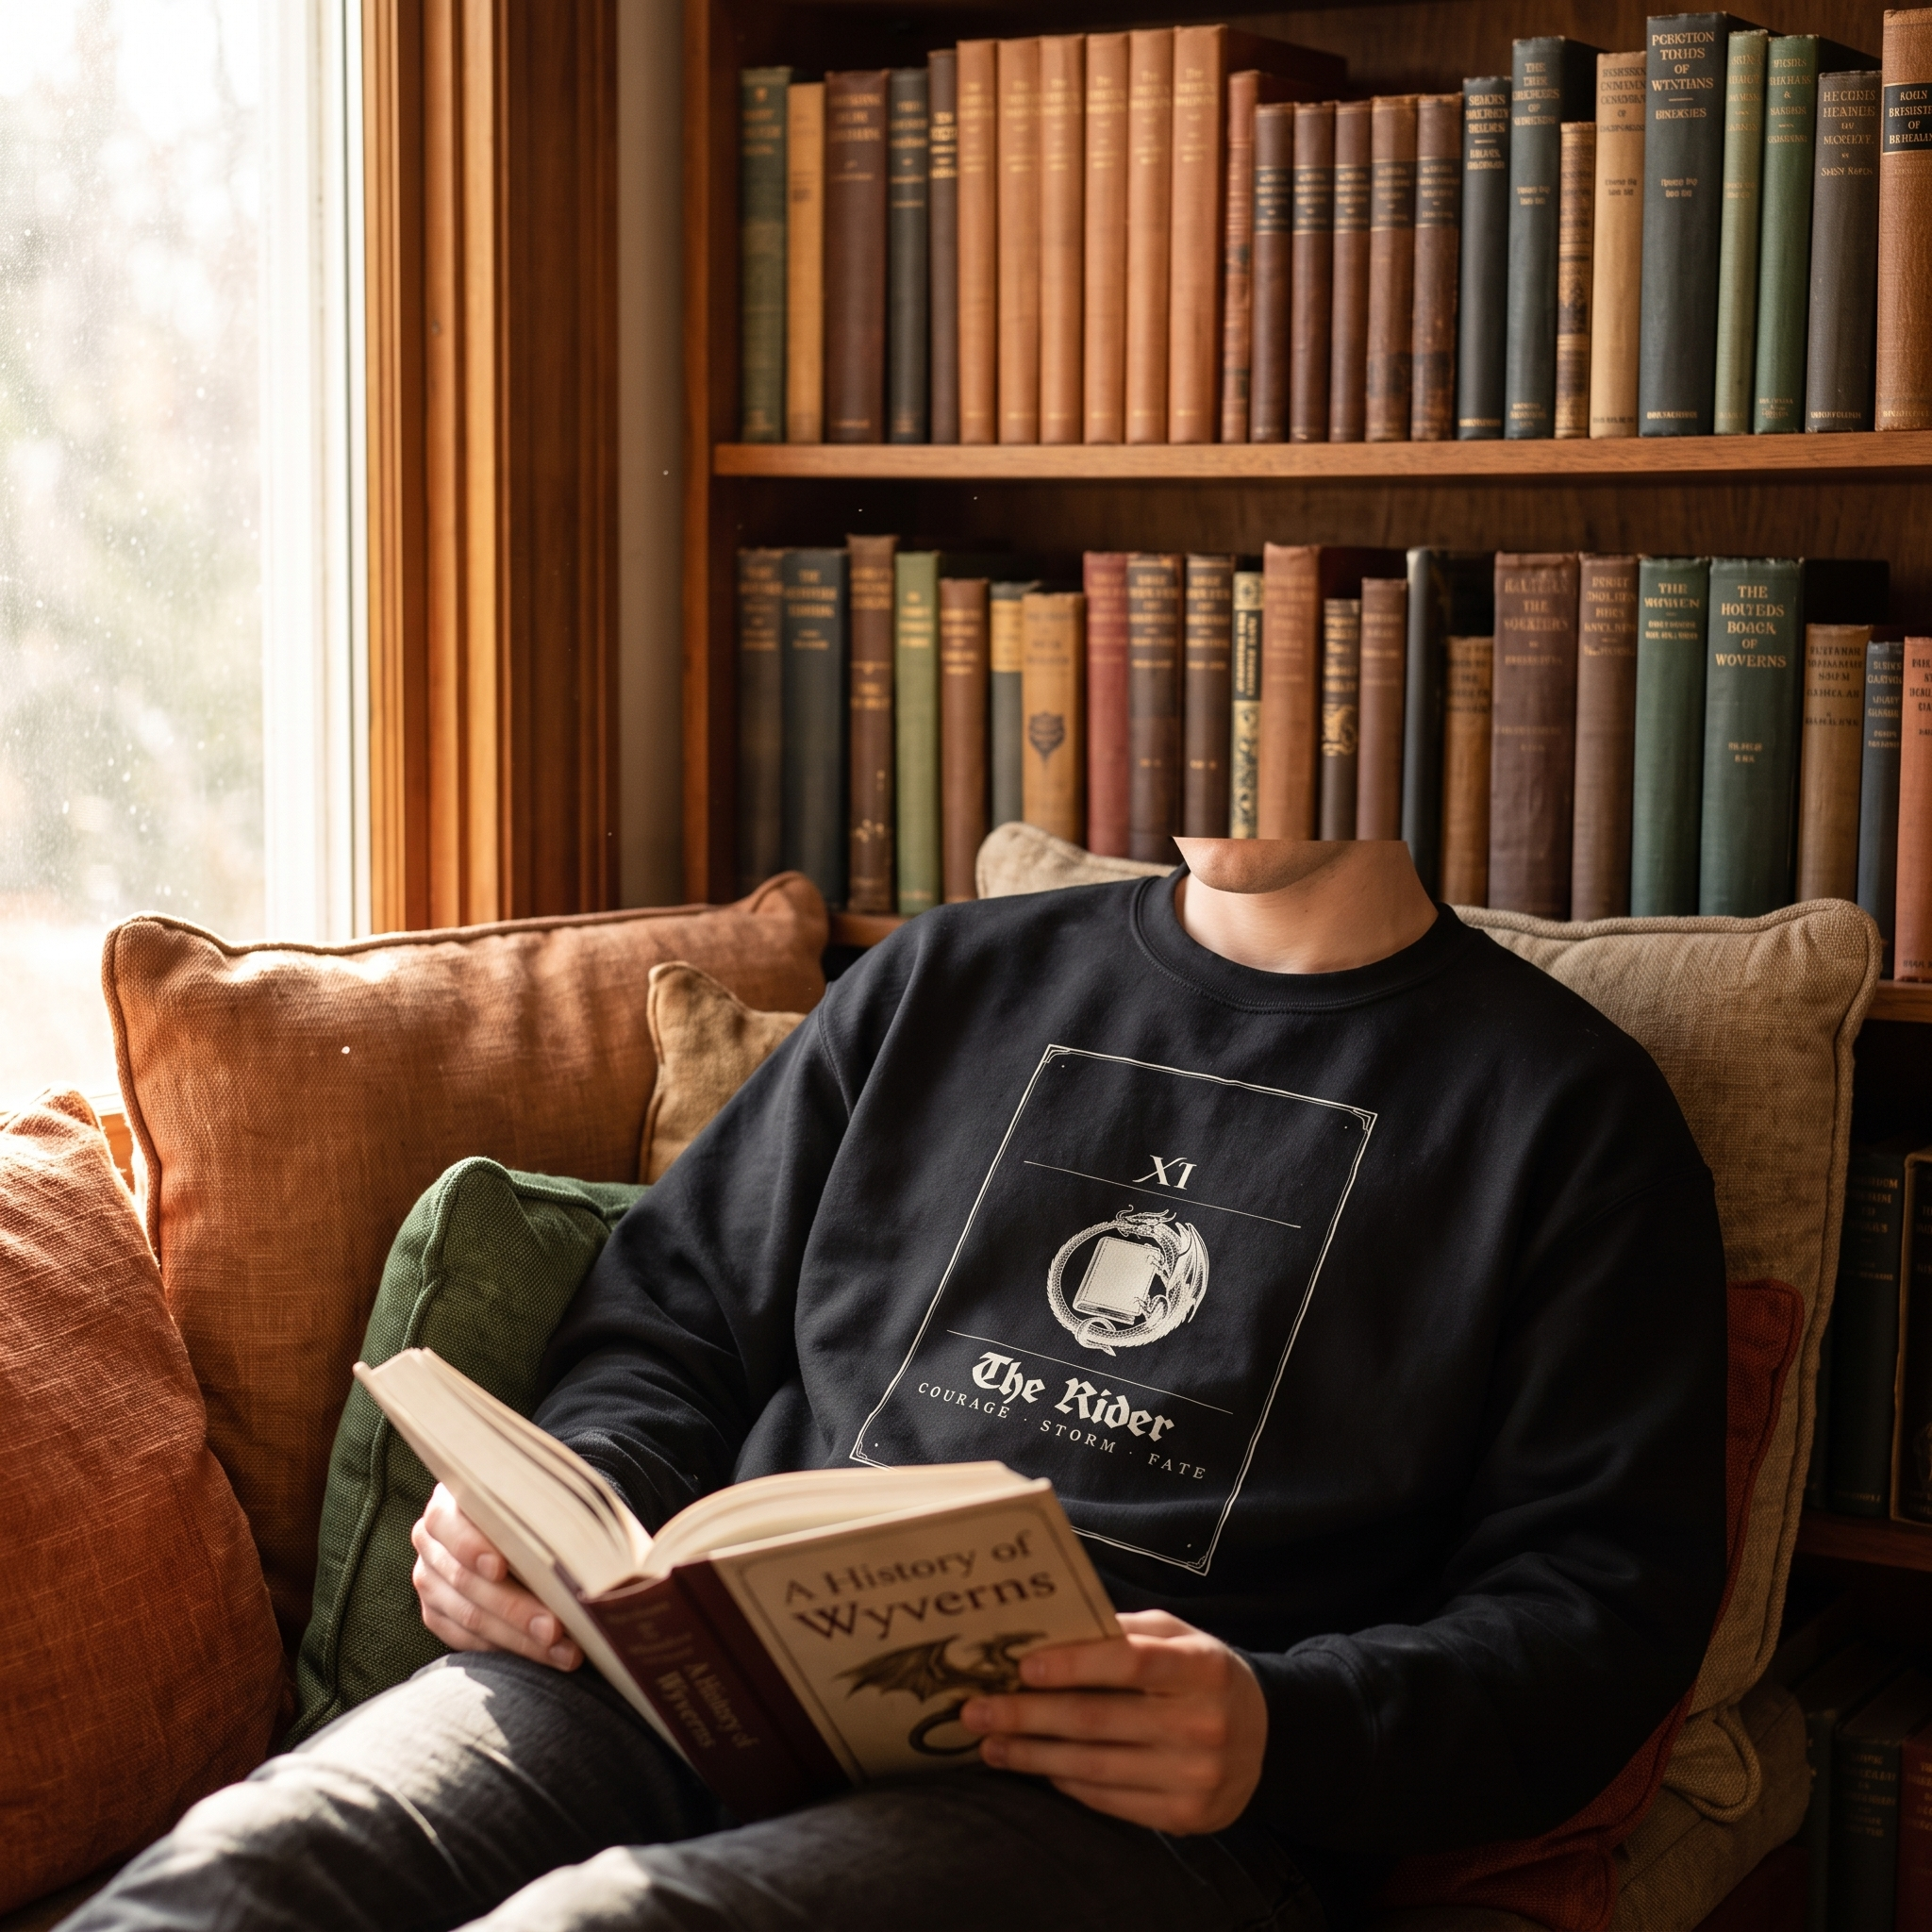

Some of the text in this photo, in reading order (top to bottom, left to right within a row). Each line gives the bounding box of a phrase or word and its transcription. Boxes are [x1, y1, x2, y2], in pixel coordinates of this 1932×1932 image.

[1674, 64, 1690, 74] OF
[1907, 120, 1921, 130] OF
[1657, 582, 1688, 594] THE
[1737, 585, 1769, 599] THE
[1740, 639, 1758, 650] OF
[1714, 653, 1787, 668] WOVERNS
[1132, 1155, 1197, 1190] XI
[972, 1351, 1175, 1441] The Rider
[918, 1382, 1207, 1479] COURAGE STORM FATE
[785, 1529, 1033, 1604] A History of
[792, 1571, 1058, 1641] Wyverns
